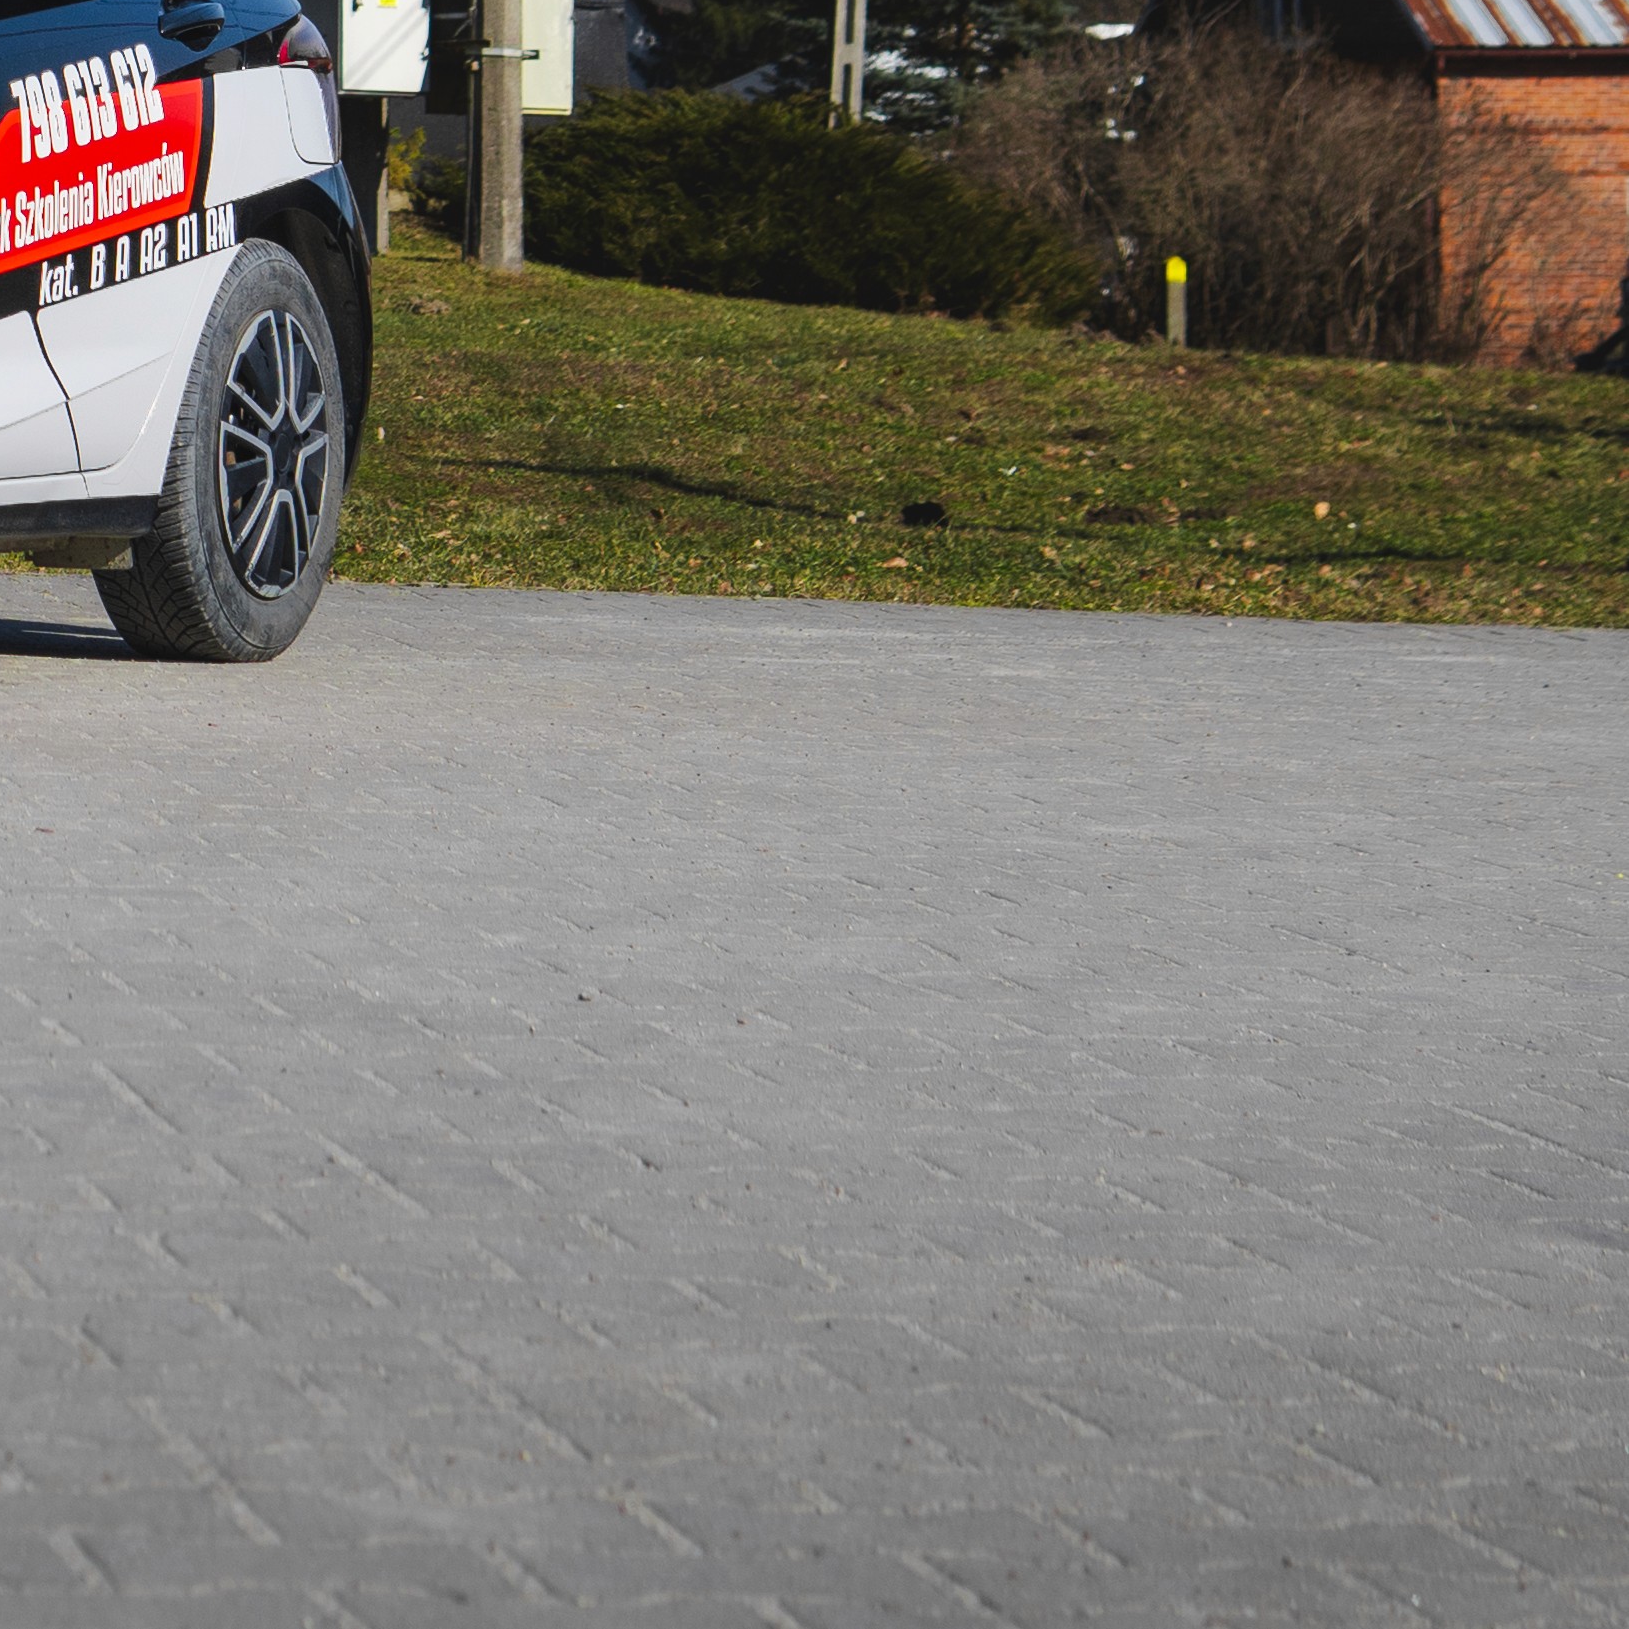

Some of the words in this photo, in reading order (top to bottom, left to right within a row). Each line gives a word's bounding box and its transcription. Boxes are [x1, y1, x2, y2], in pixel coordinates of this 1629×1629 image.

[9, 69, 69, 163] 798
[63, 56, 118, 146] 613
[110, 43, 165, 132] 612
[14, 171, 94, 249] Szkolenia
[96, 141, 185, 221] Kierowców
[39, 253, 79, 306] kat.
[90, 243, 106, 290] B
[114, 235, 131, 282] A
[139, 223, 168, 274] A2
[177, 212, 198, 262] A1
